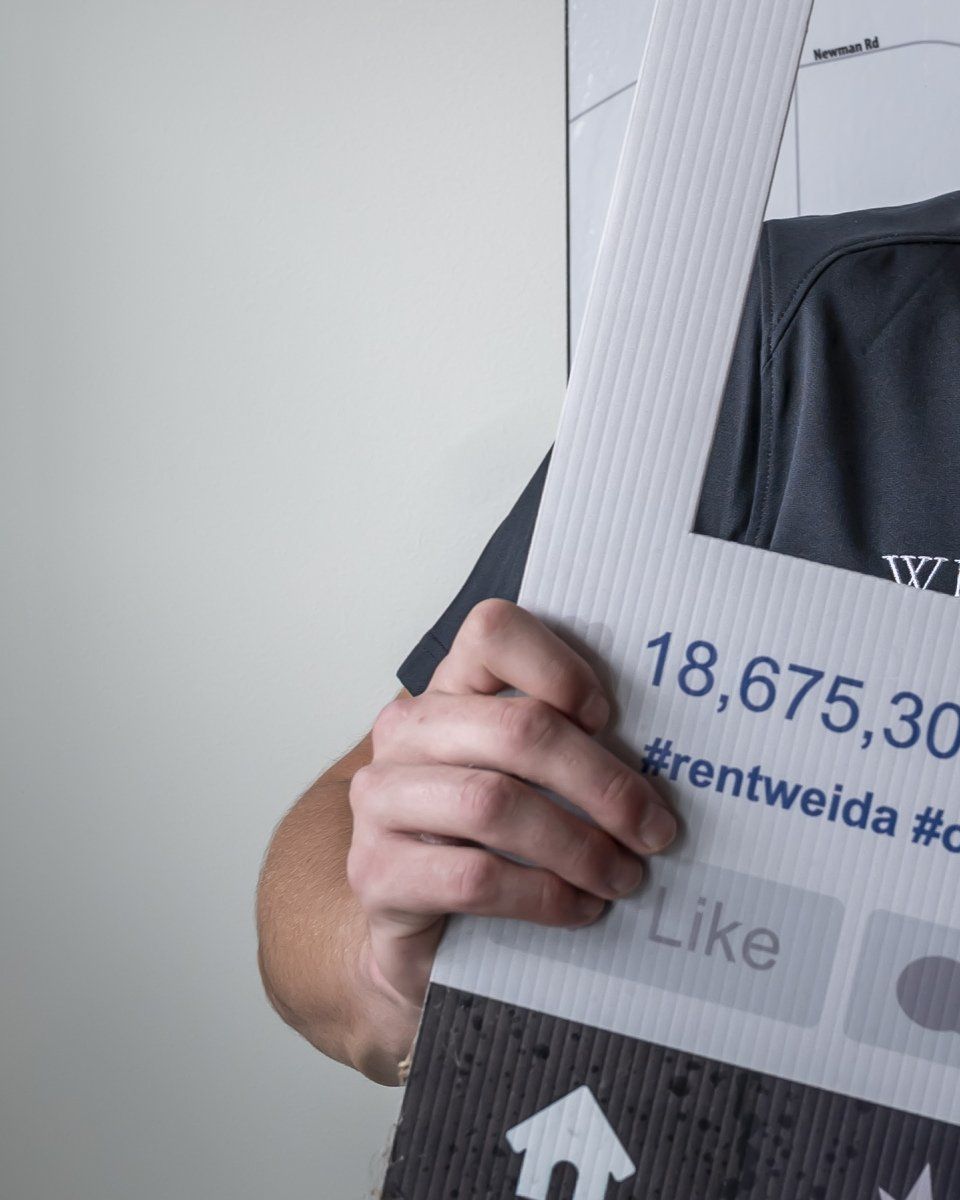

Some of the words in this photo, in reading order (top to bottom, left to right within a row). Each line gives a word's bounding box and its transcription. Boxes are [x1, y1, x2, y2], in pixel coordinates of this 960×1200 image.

[813, 43, 863, 61] Newman
[864, 36, 880, 51] Rd
[641, 737, 899, 837] #rentweida
[648, 886, 781, 971] Like
